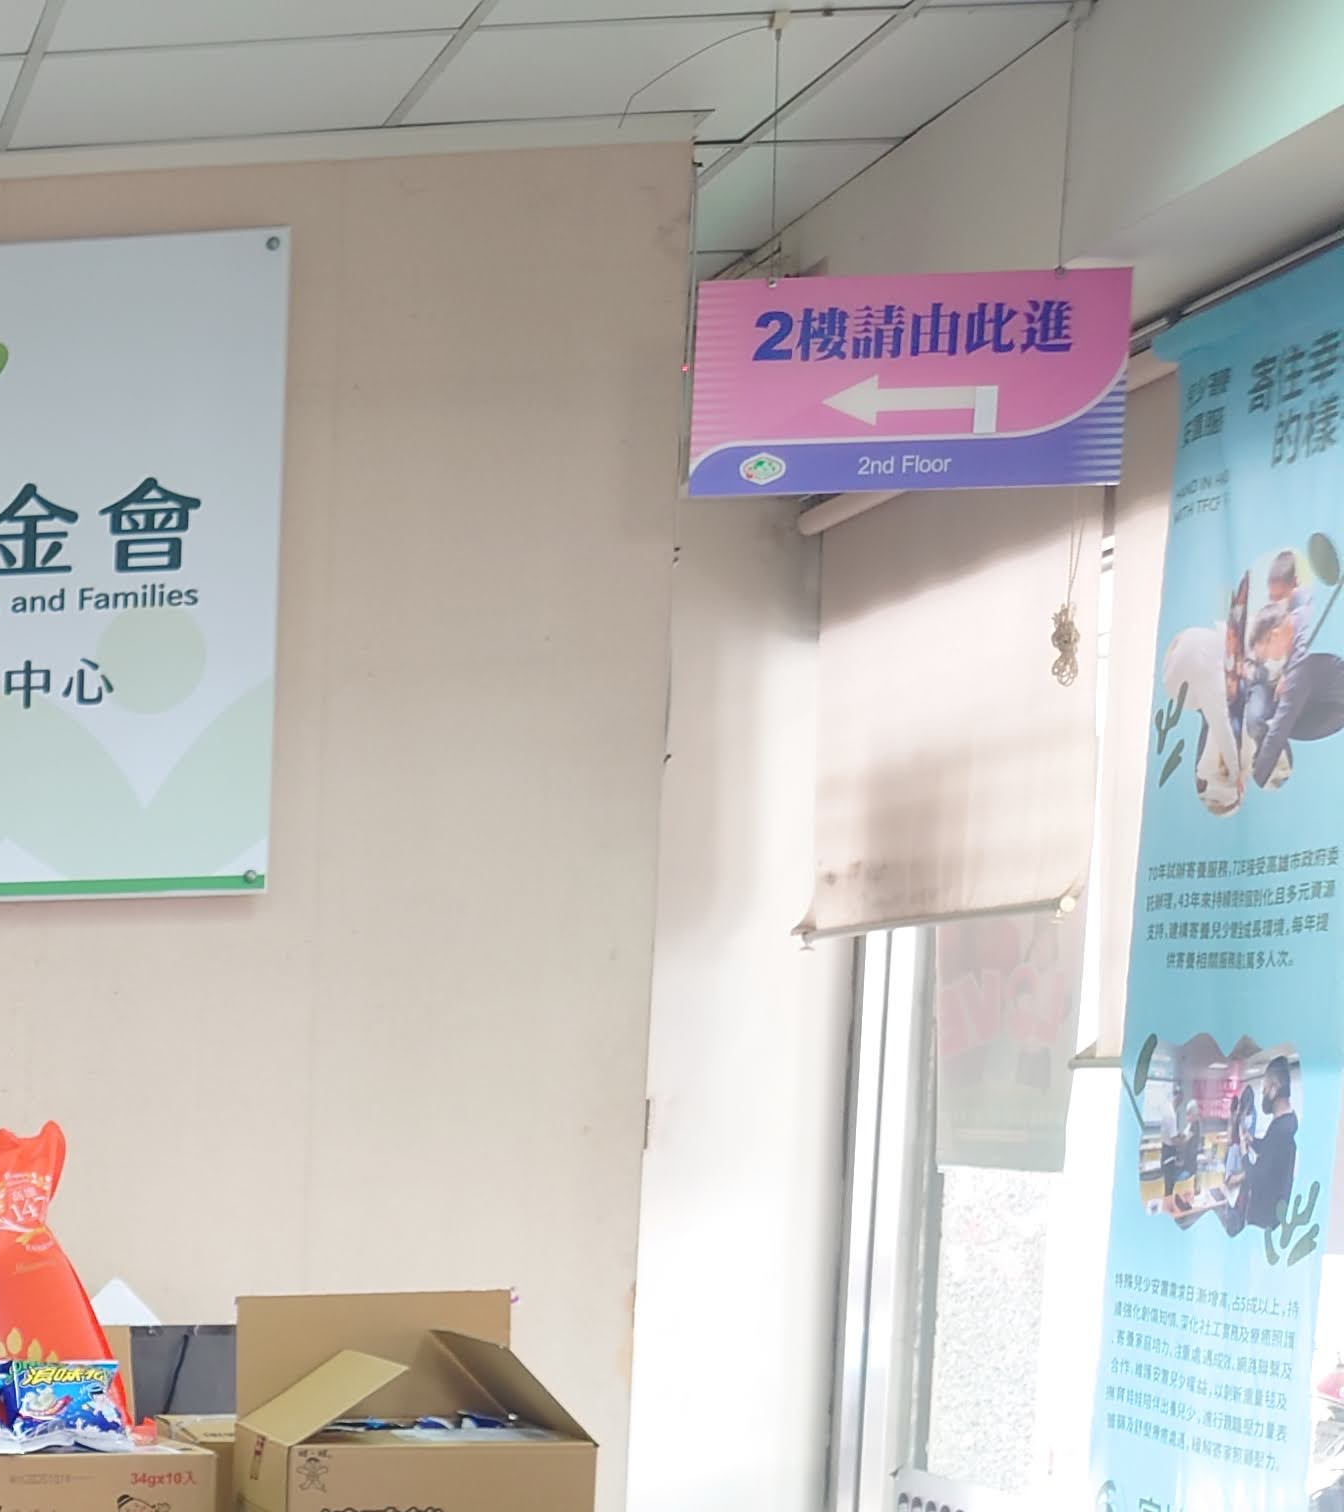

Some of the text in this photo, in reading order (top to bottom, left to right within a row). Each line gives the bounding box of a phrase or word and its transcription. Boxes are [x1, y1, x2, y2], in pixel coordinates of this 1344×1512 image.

[751, 300, 1073, 363] 2樓請由此進
[857, 453, 952, 476] 2nd Floor
[11, 587, 66, 614] and
[78, 583, 199, 610] Families
